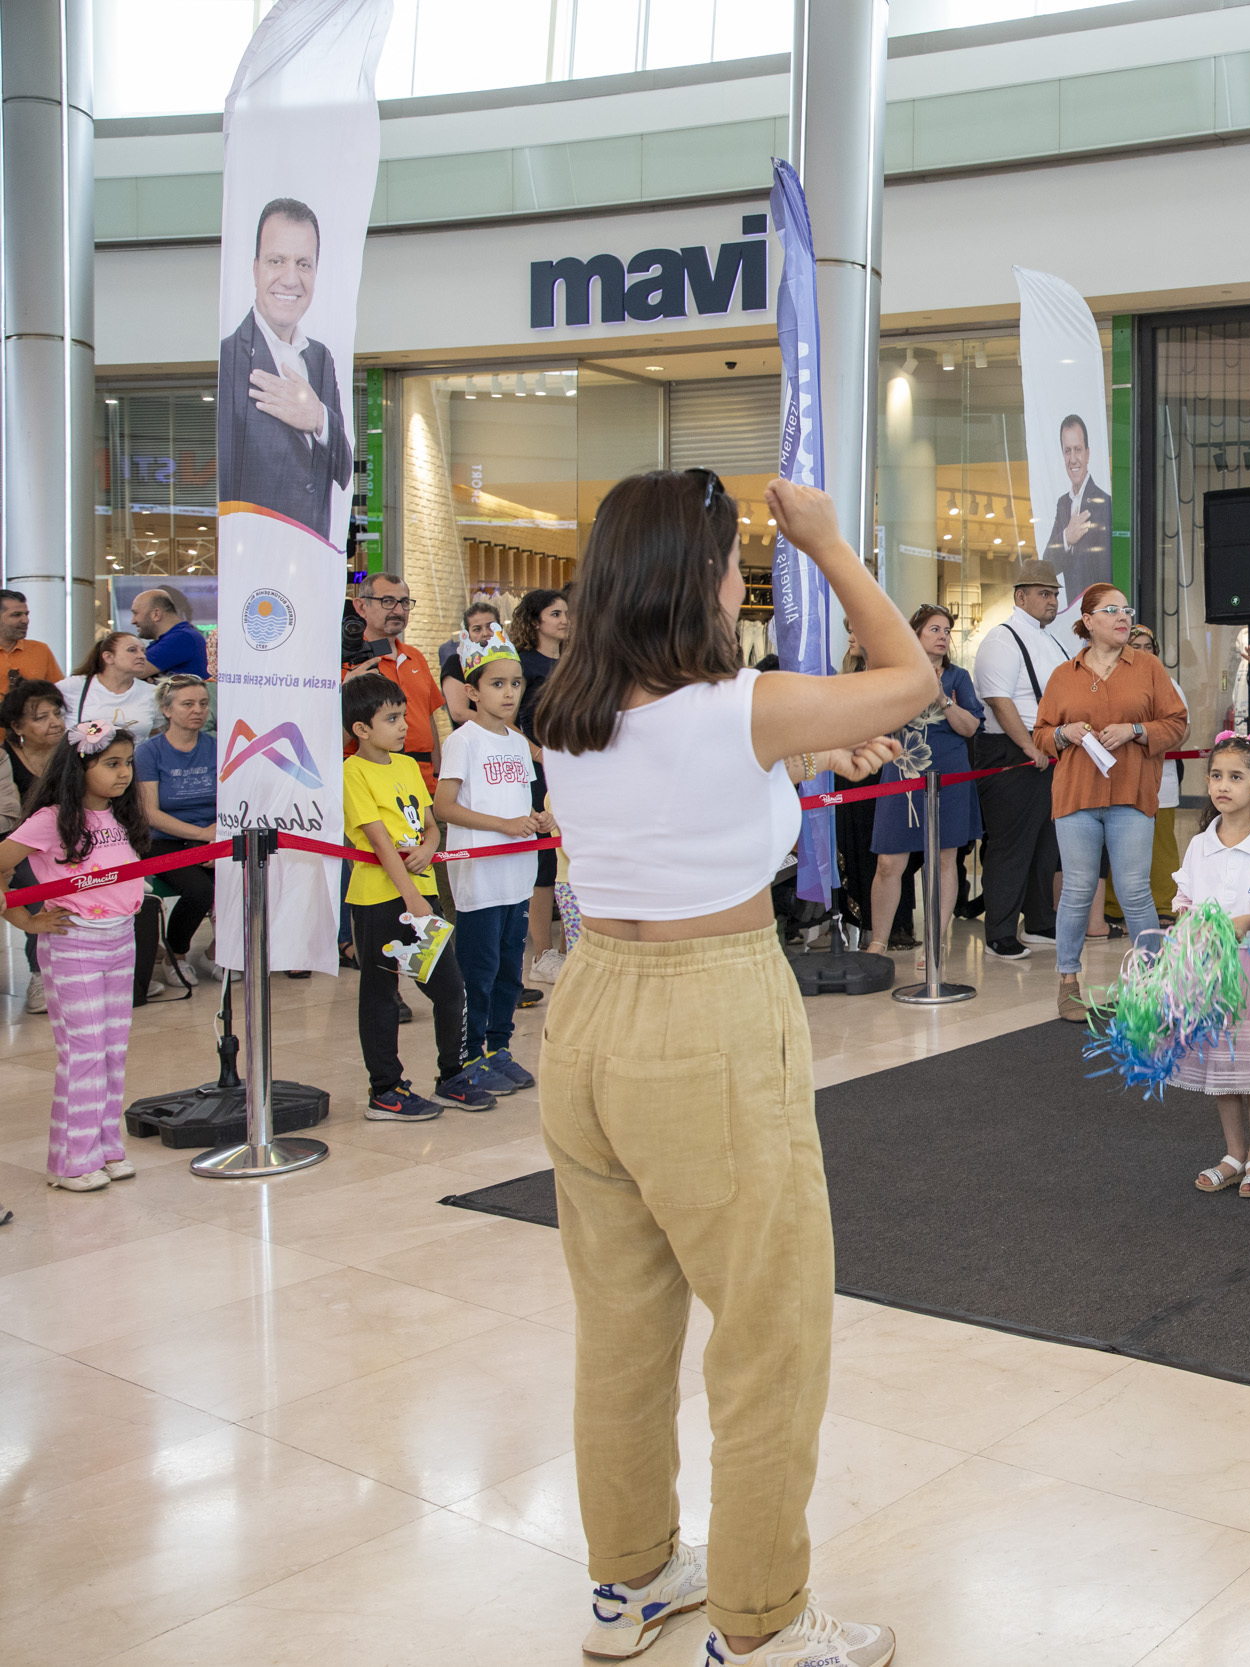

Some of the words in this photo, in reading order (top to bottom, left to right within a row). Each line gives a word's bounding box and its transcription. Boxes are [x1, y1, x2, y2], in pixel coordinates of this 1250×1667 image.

[530, 214, 768, 329] mavi
[781, 400, 799, 466] Merkezi
[70, 871, 119, 892] Palmcity
